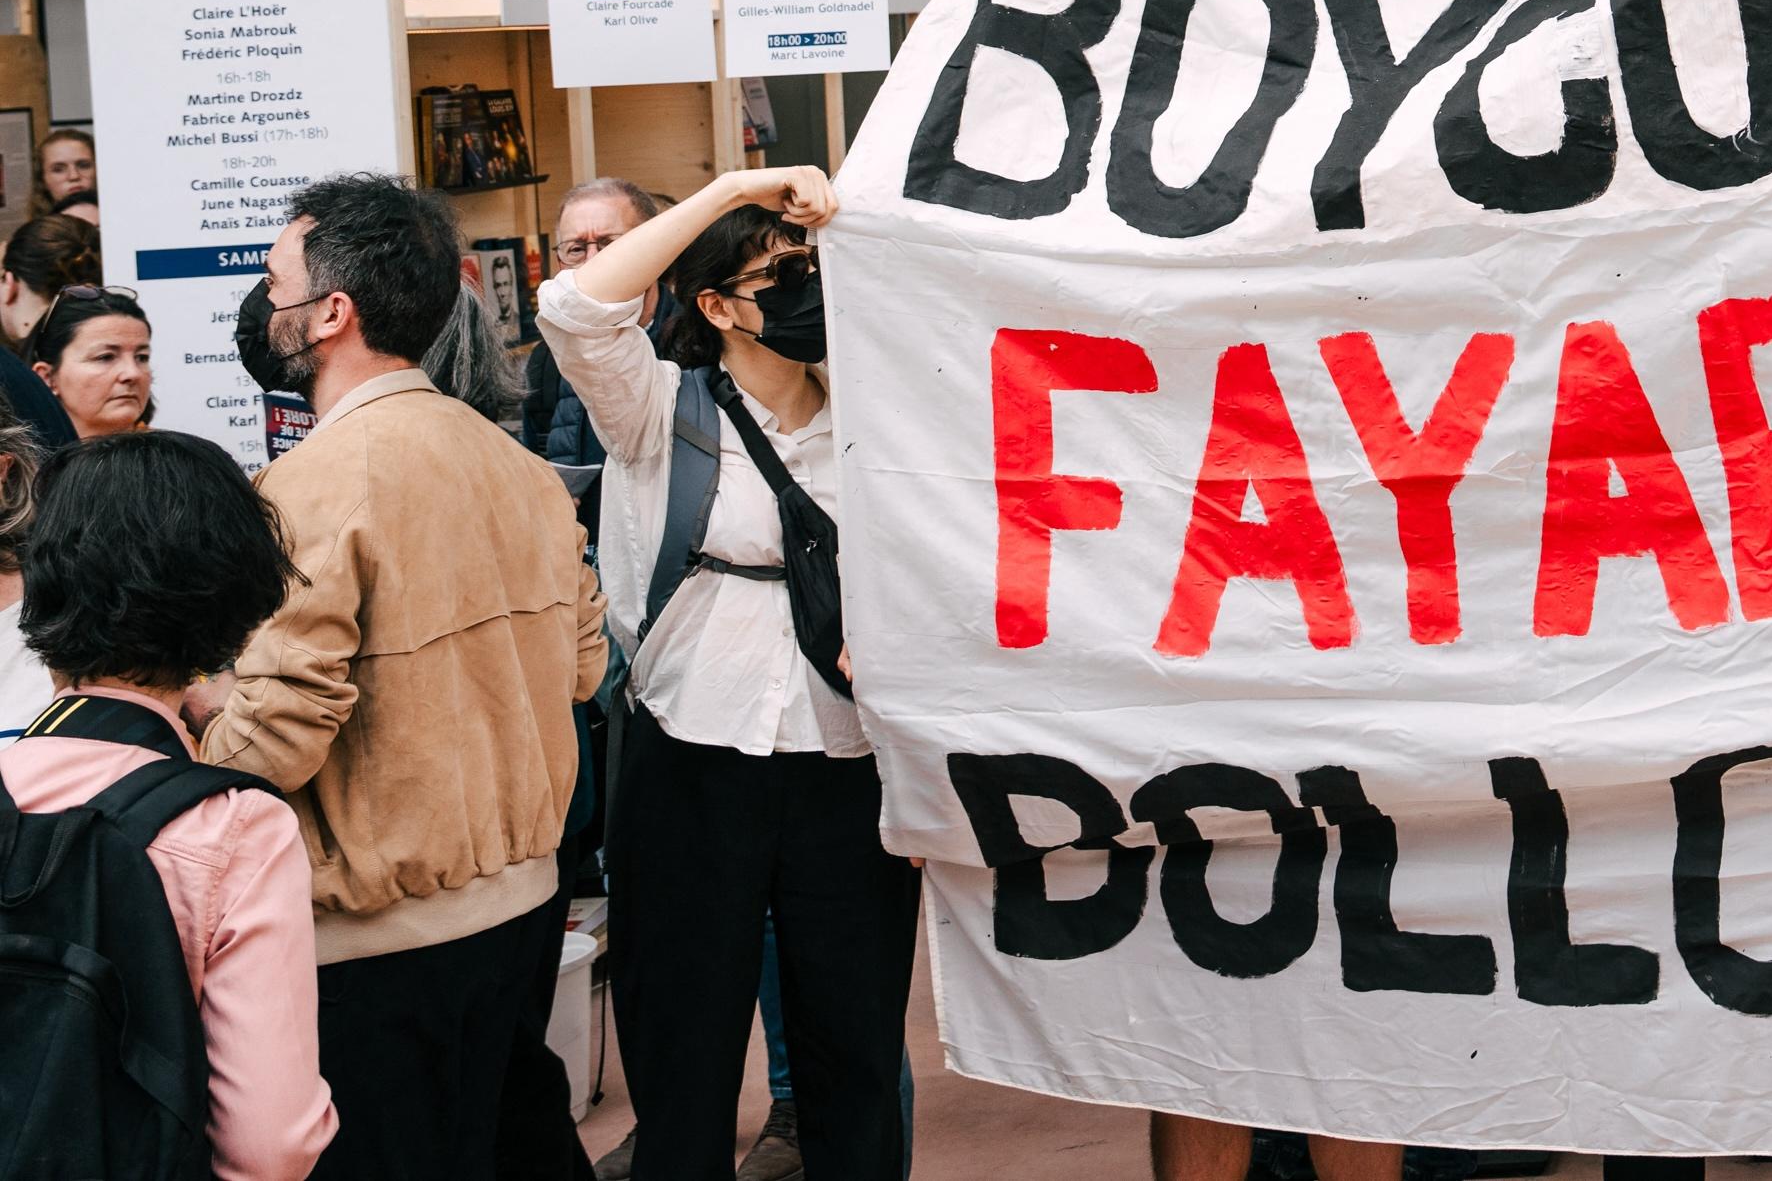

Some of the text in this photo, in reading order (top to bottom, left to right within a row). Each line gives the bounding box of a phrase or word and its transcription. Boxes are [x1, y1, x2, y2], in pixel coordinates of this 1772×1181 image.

[193, 4, 287, 20] Claire L'Hoër
[586, 0, 673, 11] Claire Fourcade
[738, 2, 874, 17] Gilles-William Goldnadel
[604, 15, 658, 26] Karl Olive
[185, 24, 297, 41] Sonia Mabrouk
[768, 36, 801, 47] 18h00
[814, 32, 847, 44] 20h00
[182, 44, 302, 61] Frédéric Ploquin
[771, 48, 845, 61] Marc Lavoine
[217, 71, 271, 84] 16h-18h
[187, 89, 302, 106] Martine Drozdz
[183, 110, 310, 126] Fabrice Argounès
[167, 127, 328, 147] Michel Bussi (17h-18h)
[222, 157, 276, 170] 18h-20h
[191, 178, 244, 191] Camille
[201, 194, 294, 211] June Nagash
[200, 218, 239, 231] Anaïs
[211, 310, 240, 323] Jérô
[206, 395, 250, 409] Claire
[229, 415, 257, 428] Karl
